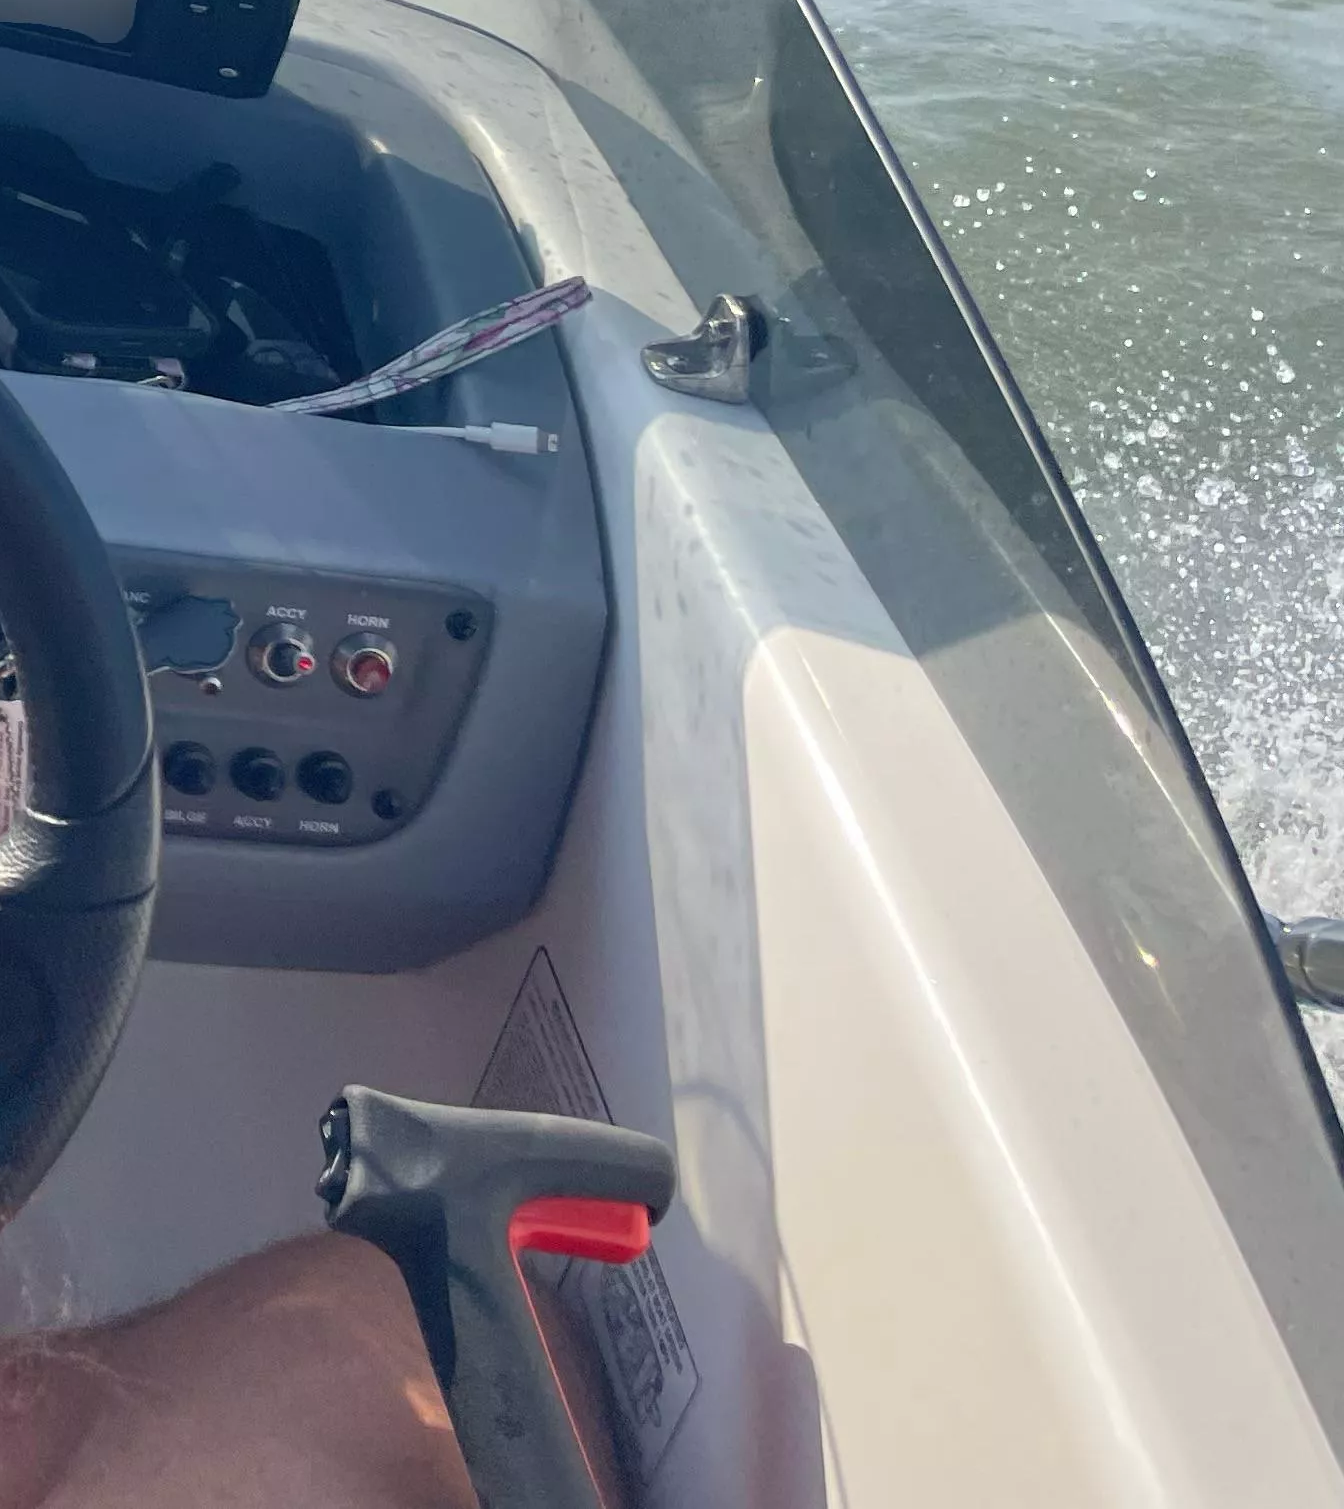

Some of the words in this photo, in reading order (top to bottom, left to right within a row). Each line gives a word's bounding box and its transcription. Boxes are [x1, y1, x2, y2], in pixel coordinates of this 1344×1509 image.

[265, 605, 308, 620] ACCY
[347, 613, 391, 629] HORN
[299, 819, 340, 834] HORN
